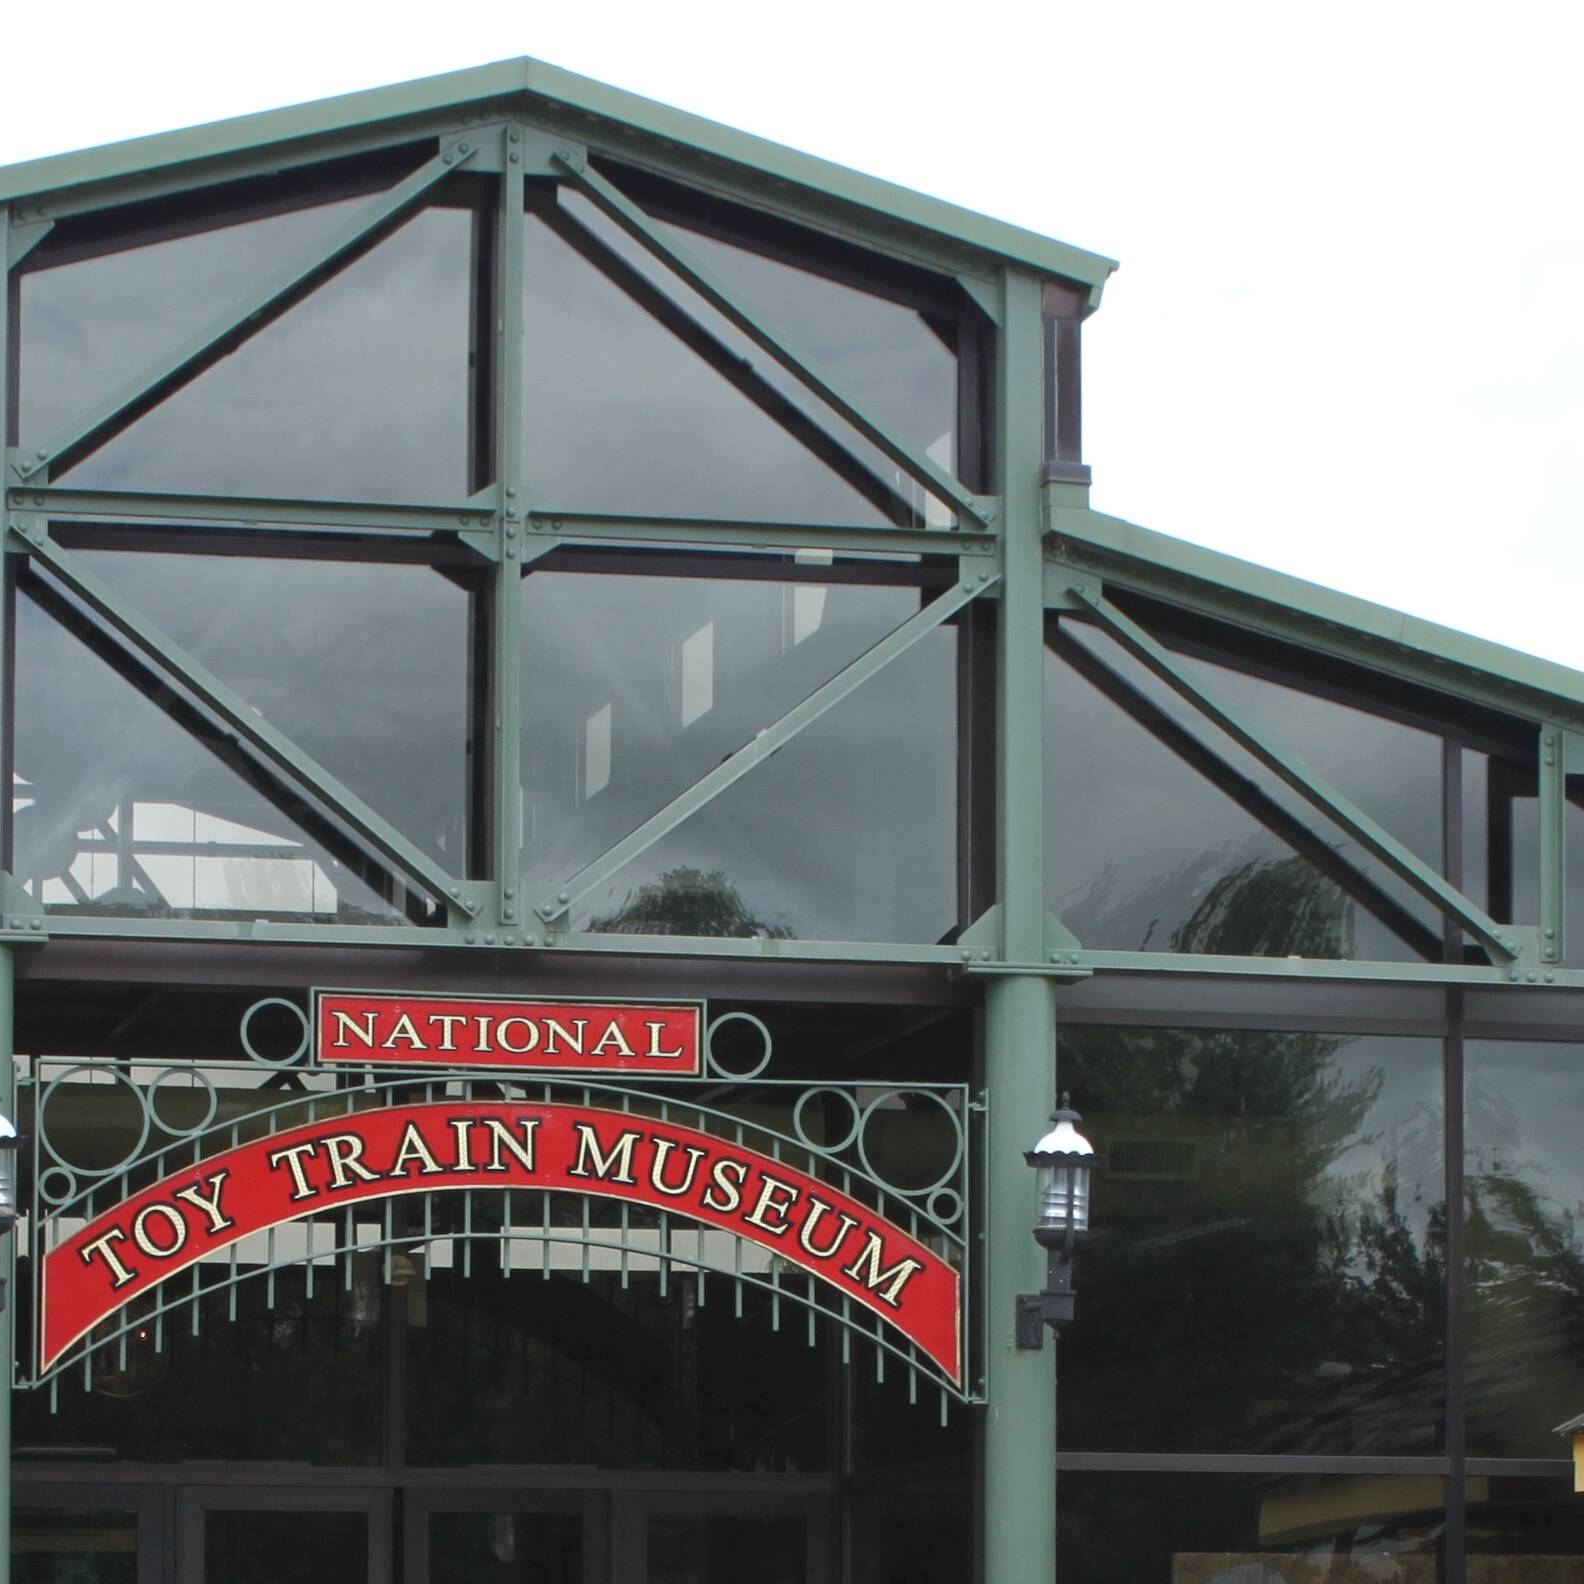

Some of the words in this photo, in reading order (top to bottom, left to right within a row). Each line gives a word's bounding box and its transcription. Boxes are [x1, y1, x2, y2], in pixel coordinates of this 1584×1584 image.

[330, 1008, 686, 1061] NATIONAL
[80, 1173, 234, 1292] TOY
[269, 1115, 541, 1202] TRAIN
[570, 1119, 925, 1311] MUSEUM
